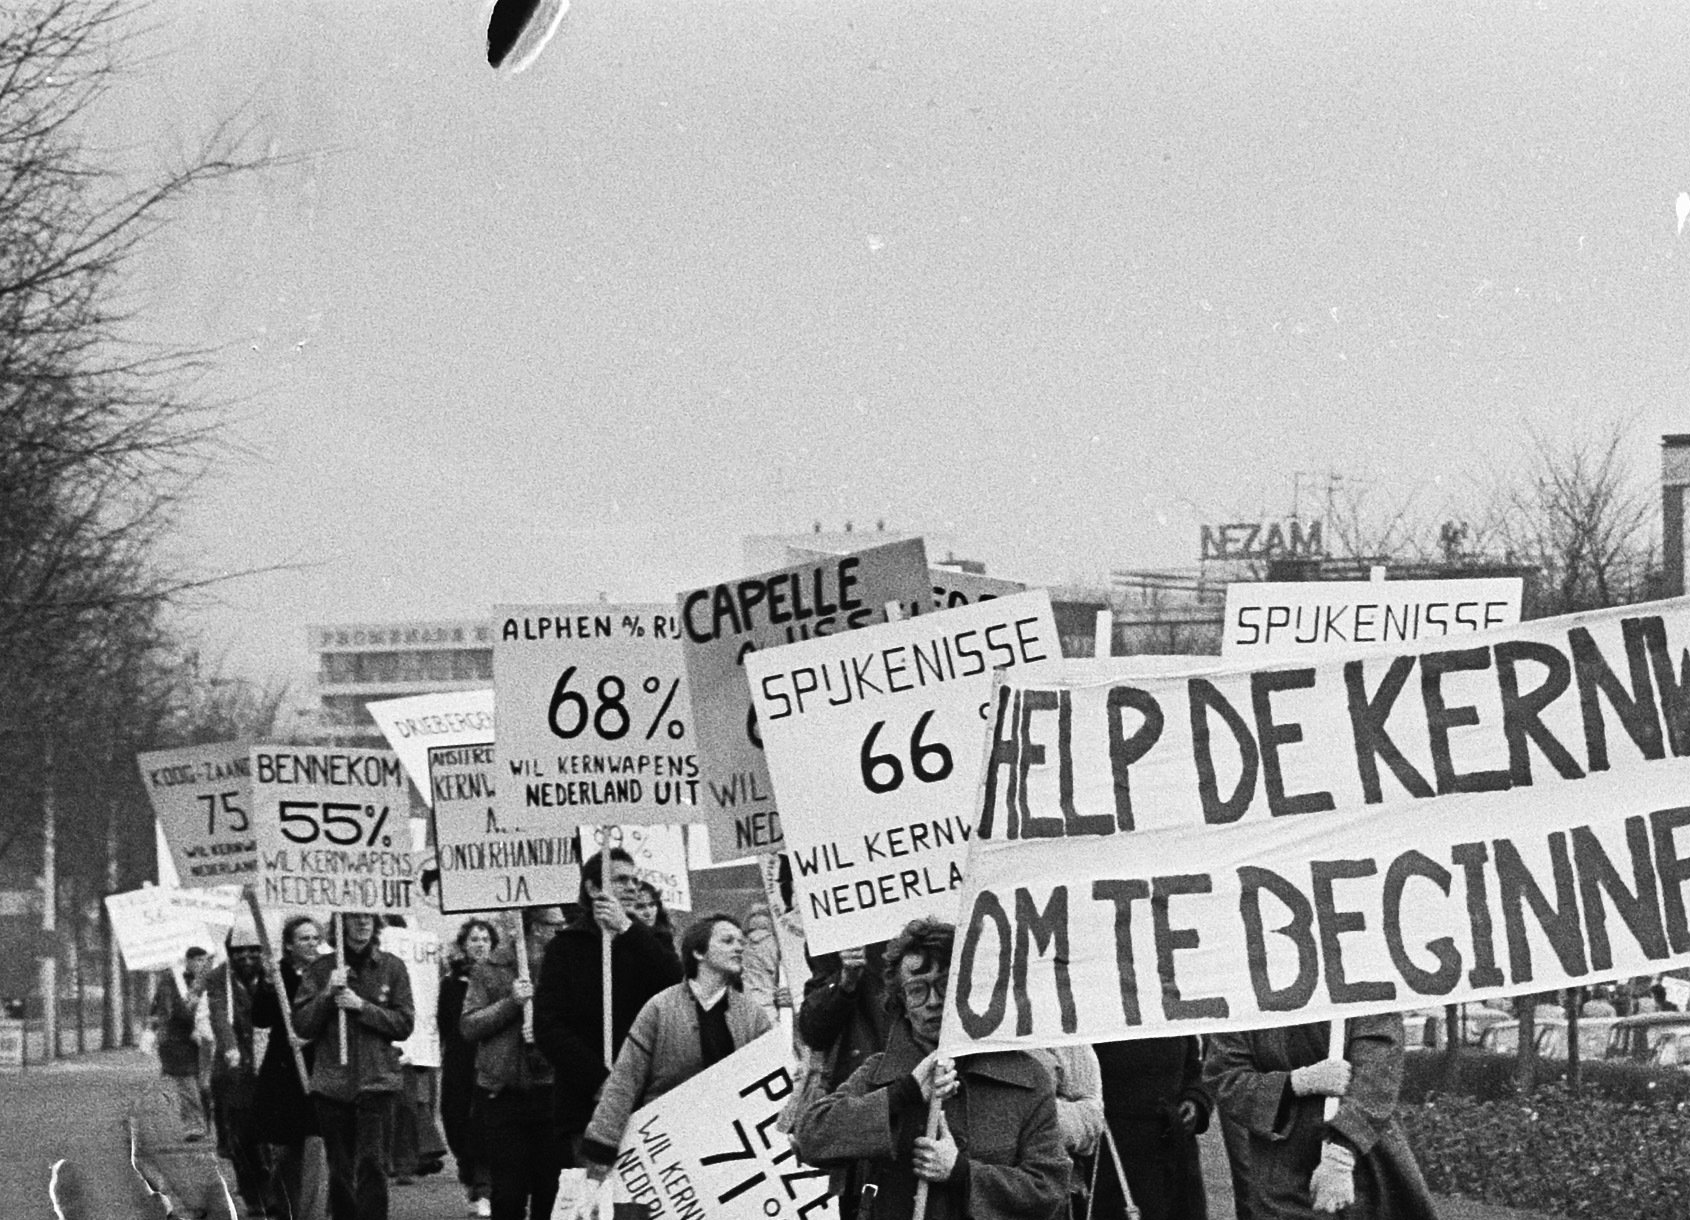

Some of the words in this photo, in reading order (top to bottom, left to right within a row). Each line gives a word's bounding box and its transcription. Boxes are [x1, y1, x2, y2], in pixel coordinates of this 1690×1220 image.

[682, 556, 862, 644] CAPELLE
[503, 615, 612, 641] ALPHEN
[548, 665, 685, 740] 68%
[257, 753, 402, 787] BENNEKOM
[509, 758, 544, 778] WIL
[557, 754, 700, 778] KERNWAPENS
[974, 685, 1164, 841] HELP
[1188, 668, 1336, 826] DE
[526, 778, 643, 807] NEDERLAND
[655, 779, 701, 806] UIT
[709, 771, 768, 808] WIL
[197, 791, 249, 835] 75
[278, 801, 392, 847] 55%
[263, 850, 295, 873] WIL
[300, 849, 413, 878] KERNWAPENS
[794, 842, 855, 877] WIL
[265, 875, 379, 907] NEDERLAND
[383, 879, 414, 908] UIT
[496, 875, 533, 902] JA
[958, 883, 1078, 1040] OM
[1091, 871, 1229, 1027] TE
[638, 1114, 672, 1164] WIL
